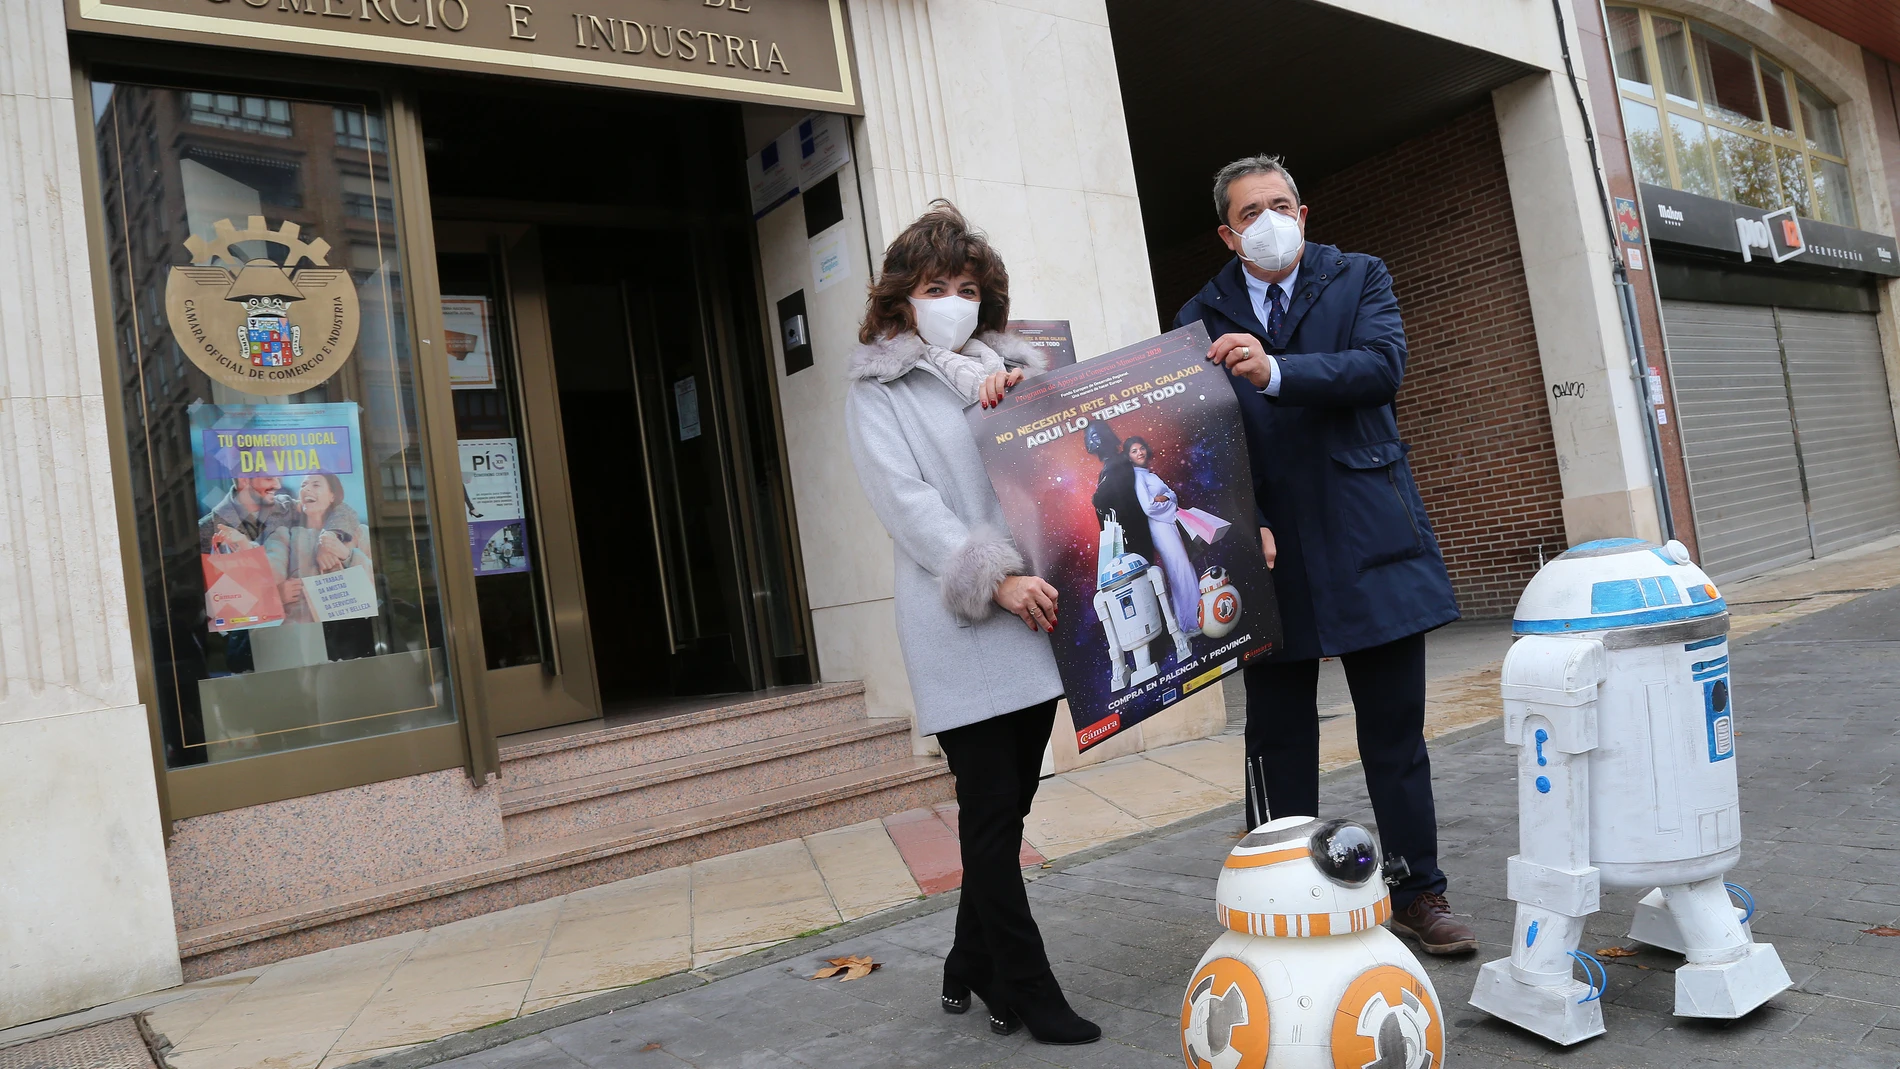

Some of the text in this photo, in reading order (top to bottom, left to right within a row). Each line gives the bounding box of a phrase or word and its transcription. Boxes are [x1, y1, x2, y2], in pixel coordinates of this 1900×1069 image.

[205, 0, 791, 75] RCIO E INDUSTRIA
[1657, 203, 1685, 222] Mahou
[1808, 244, 1864, 262] CERVECERÍA
[204, 343, 245, 375] OFICIAL
[250, 369, 264, 380] DE
[268, 353, 325, 380] COMERCIO
[321, 345, 333, 356] E
[327, 296, 344, 347] INDUSTRIA
[1015, 387, 1048, 403] Programa
[1048, 383, 1057, 391] de
[1057, 376, 1079, 389] Apoyo
[1086, 364, 1116, 378] Comercio
[1116, 354, 1147, 369] Minorista
[1147, 347, 1162, 357] 2020
[995, 364, 1204, 445] NO NECESITAS IRTE A OTRA GALAXIA
[1026, 381, 1187, 449] AQUI LO TIENES TODO
[217, 431, 338, 448] TU COMERCIO LOCAL
[240, 448, 322, 473] DA VIDA
[322, 575, 344, 586] TRABAJO
[326, 582, 347, 593] AMISTAD
[329, 591, 350, 602] RIQUEZA
[333, 598, 358, 609] SERVICIOS
[350, 602, 371, 614] BELLEZA
[1243, 642, 1273, 662] Cámara
[1108, 688, 1145, 710] COMPRA
[1146, 682, 1158, 692] EN
[1159, 660, 1199, 685] PALENCIA
[1200, 655, 1208, 664] Y
[1209, 633, 1252, 660] PROVINCIA
[1080, 718, 1118, 745] Cámara
